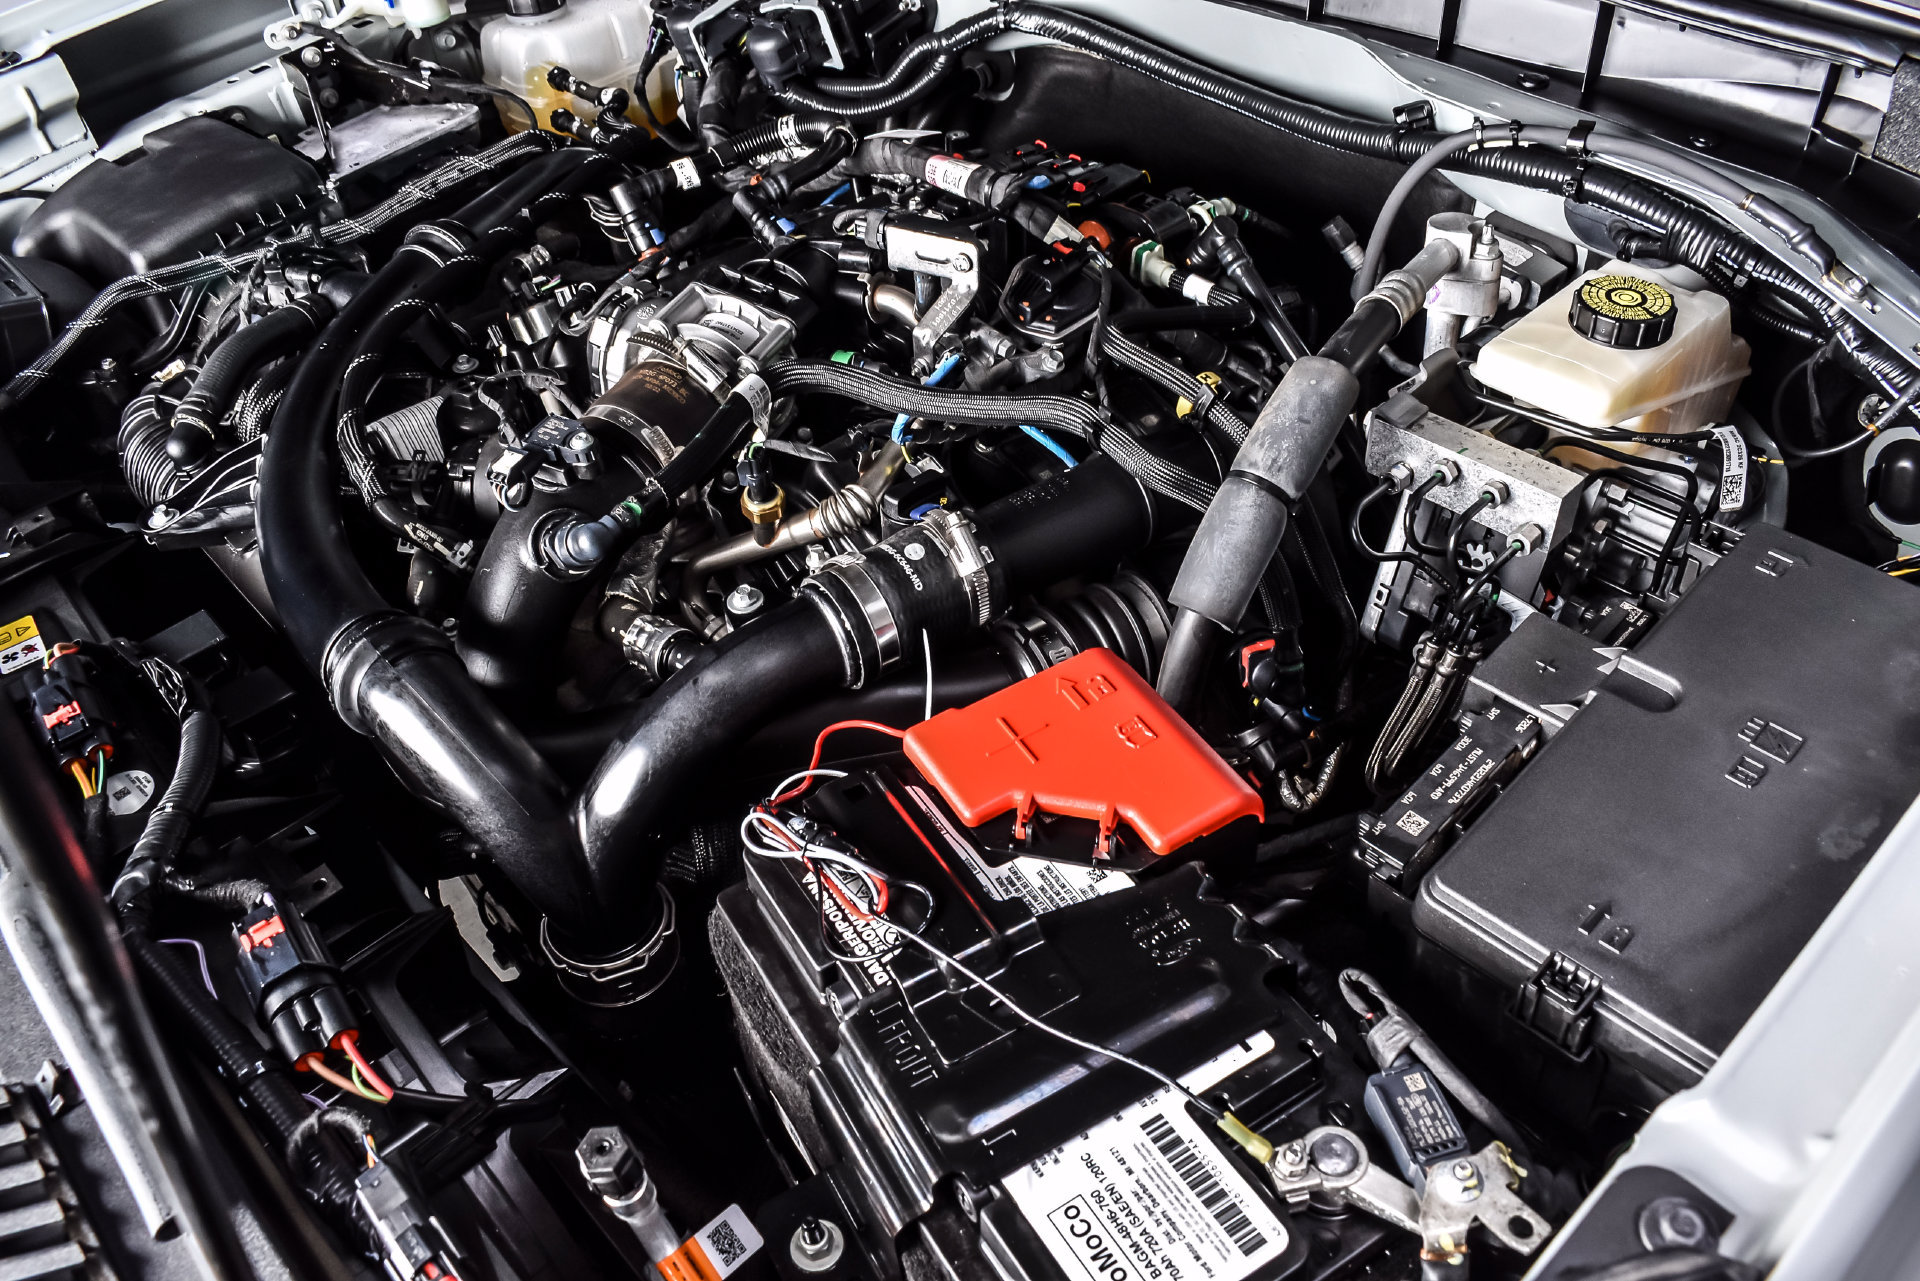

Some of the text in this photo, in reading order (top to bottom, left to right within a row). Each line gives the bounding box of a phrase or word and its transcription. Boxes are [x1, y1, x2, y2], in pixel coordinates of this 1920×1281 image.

[878, 542, 924, 592] 3G-6C646-MD
[1454, 735, 1472, 750] 300A
[1109, 1147, 1125, 1165] 48121
[1125, 1166, 1133, 1175] MI
[1080, 1152, 1184, 1281] 70Ah 720A (SAE/EN) 120RC
[1063, 1203, 1130, 1281] oMoCo
[1090, 1188, 1162, 1280] BAGM-48H6-760
[1184, 1242, 1201, 1261] Motor
[1200, 1261, 1214, 1278] Ford
